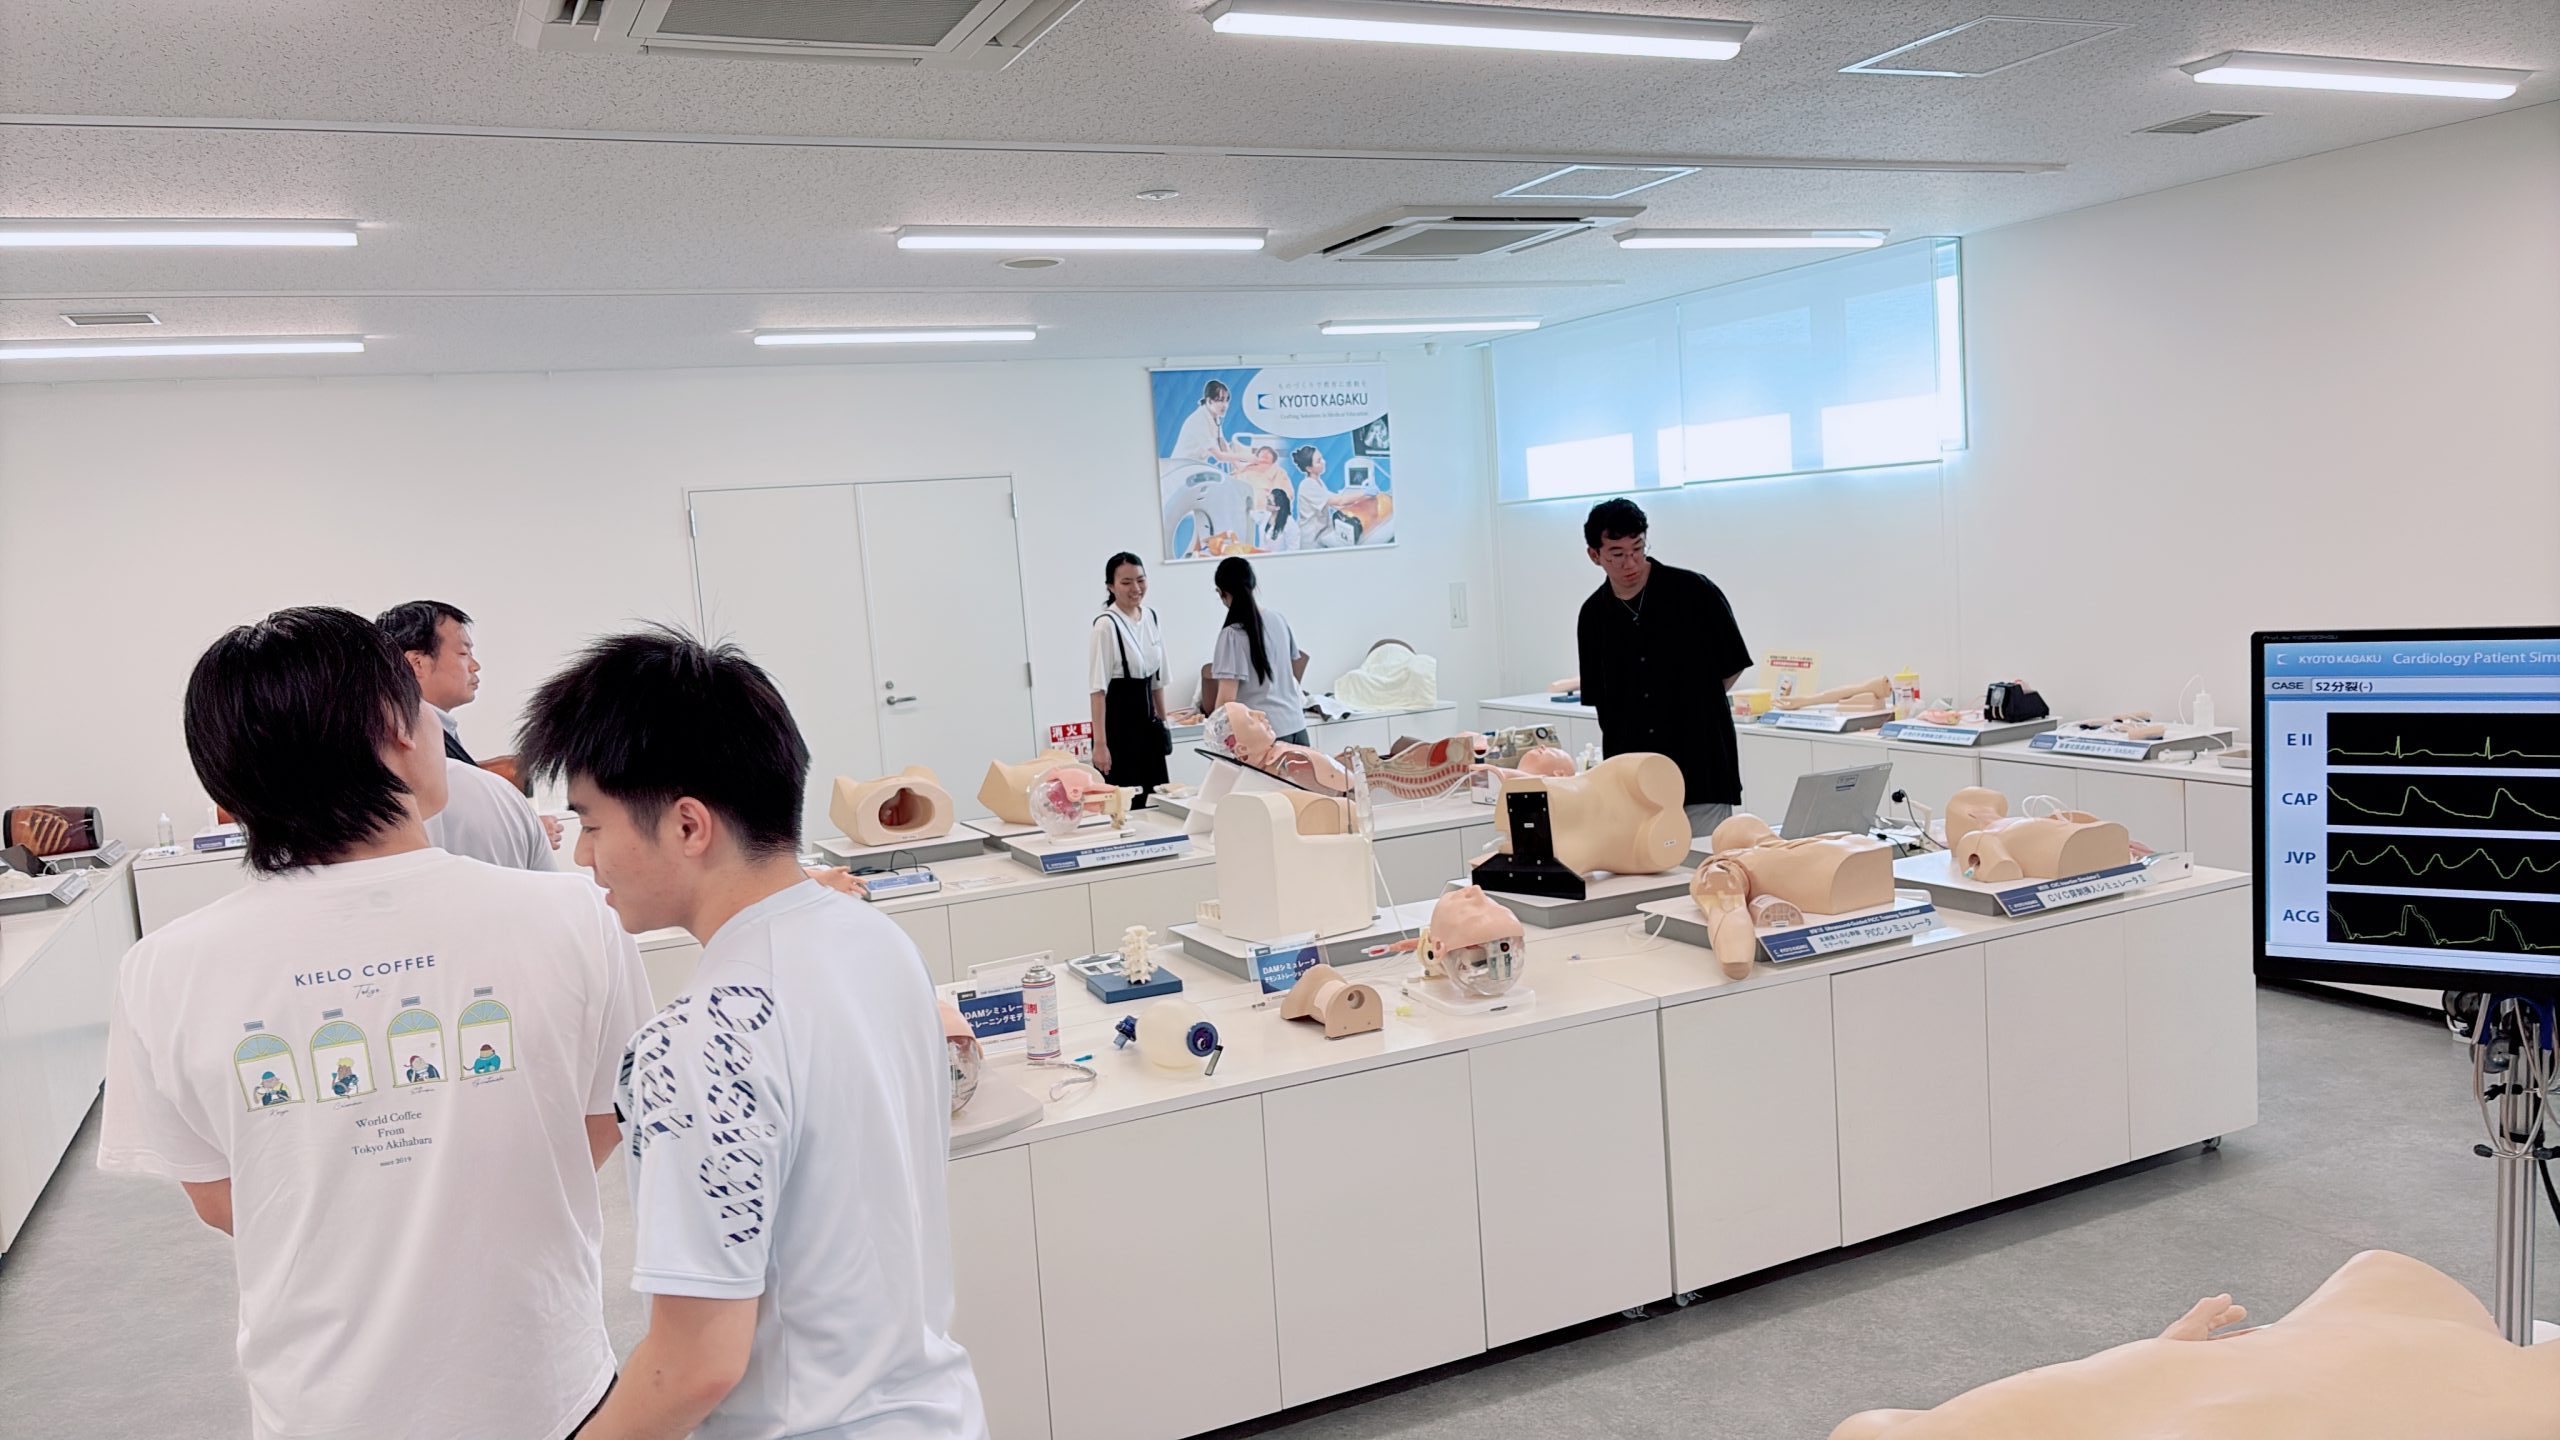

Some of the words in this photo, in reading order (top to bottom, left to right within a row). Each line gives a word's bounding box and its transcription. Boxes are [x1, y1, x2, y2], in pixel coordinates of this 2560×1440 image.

[1279, 394, 1319, 408] KYOTO
[1320, 392, 1368, 407] KAGAKU
[2298, 655, 2335, 664] KYOTO
[2337, 655, 2382, 664] KAGAKU
[2392, 652, 2471, 667] Cardiology
[2474, 652, 2525, 664] Patient
[2271, 682, 2304, 690] CASE
[2287, 733, 2297, 747] E
[2282, 792, 2318, 806] CAP
[2284, 851, 2316, 865] JVP
[2283, 909, 2320, 923] ACG
[294, 968, 351, 986] KIELO
[362, 955, 436, 977] COFFEE
[964, 1003, 1023, 1020] DAMシミュレー
[969, 1012, 1024, 1028] トレーニングモデ
[639, 995, 694, 1149] hat
[355, 1114, 388, 1128] World
[389, 1110, 422, 1122] Coffee
[700, 986, 776, 1247] Design
[377, 1127, 405, 1138] From
[351, 1144, 384, 1156] Tokyo
[386, 1136, 433, 1151] Akihabara
